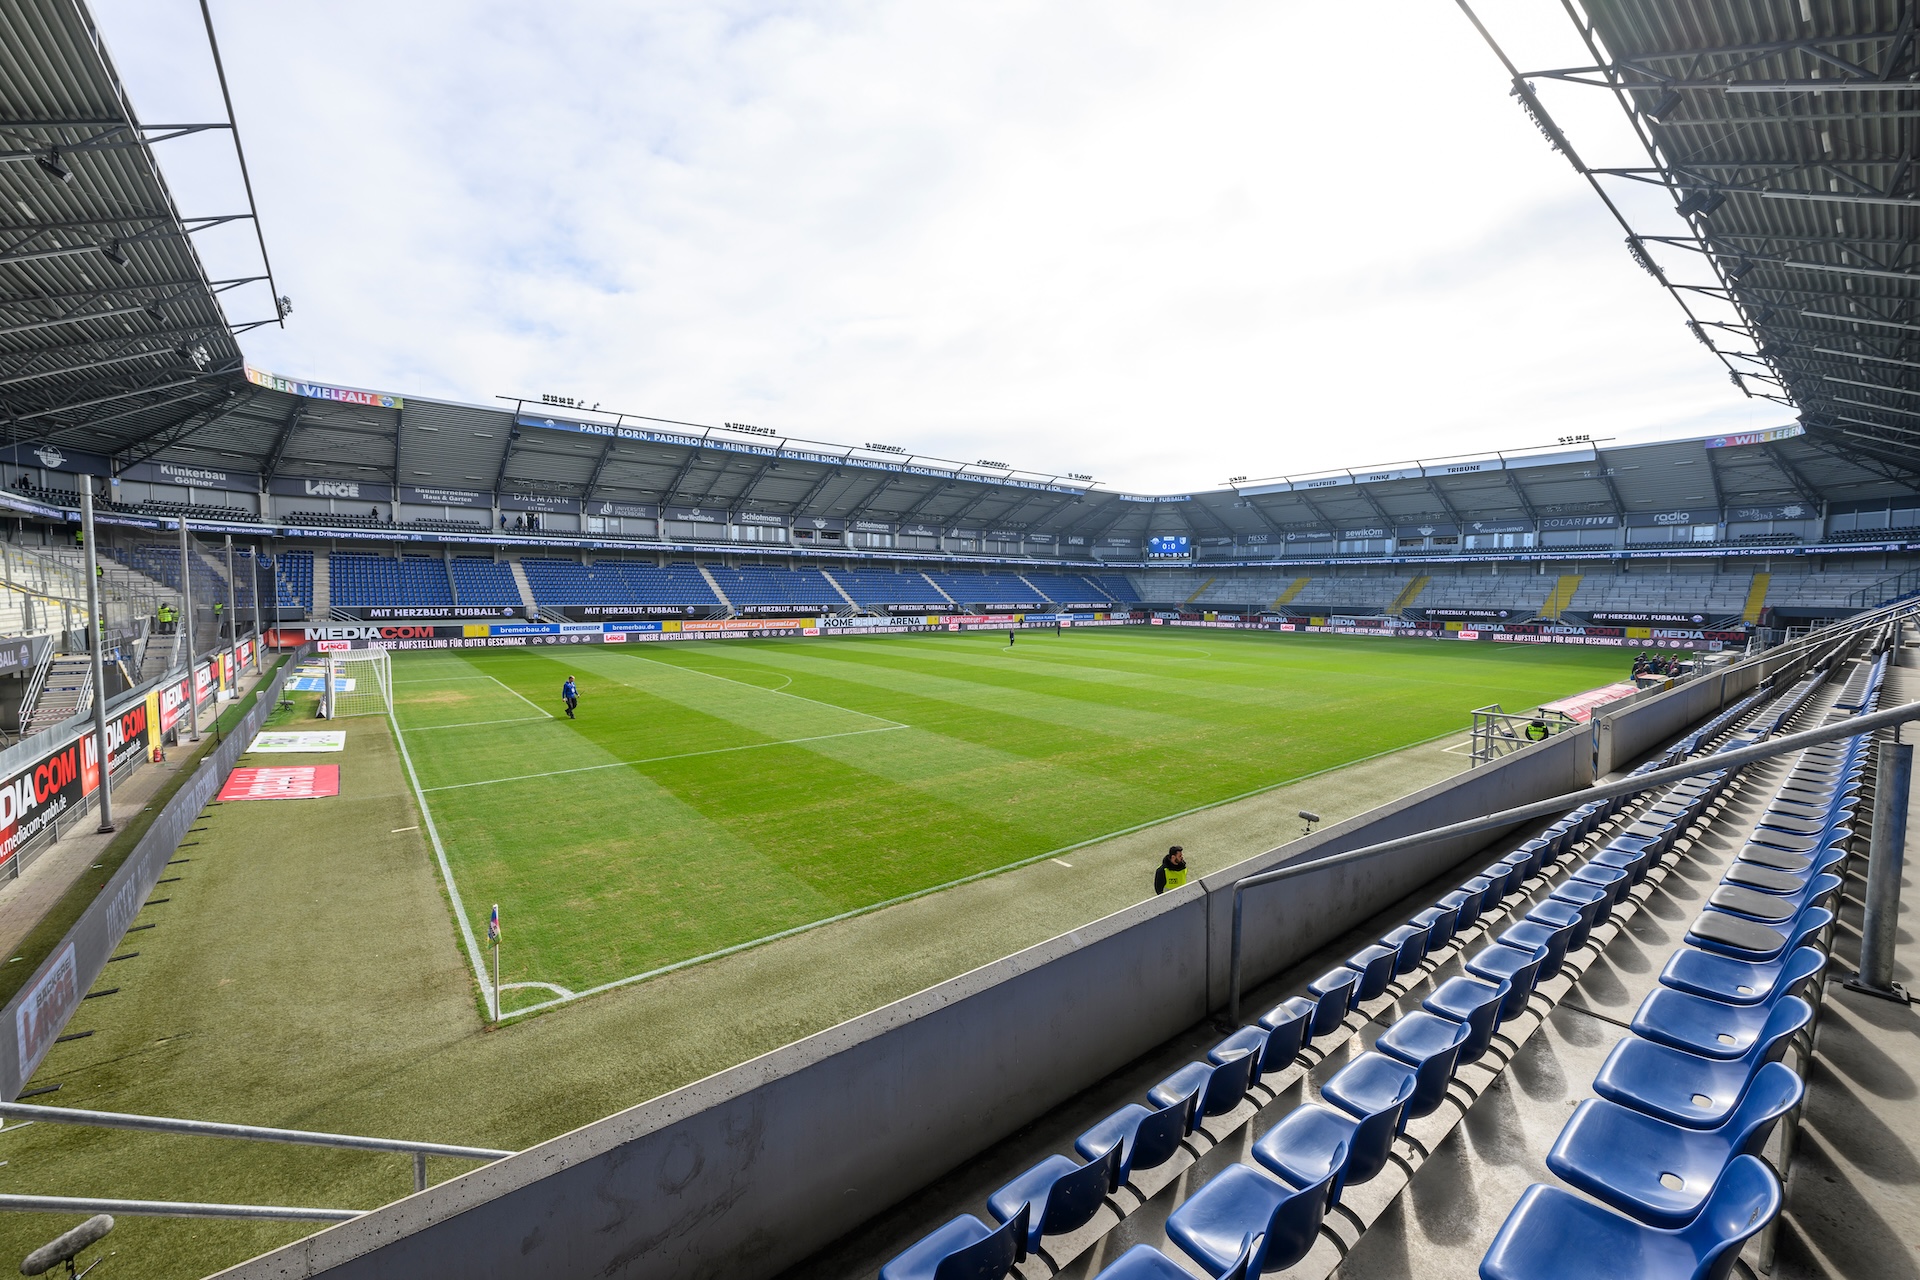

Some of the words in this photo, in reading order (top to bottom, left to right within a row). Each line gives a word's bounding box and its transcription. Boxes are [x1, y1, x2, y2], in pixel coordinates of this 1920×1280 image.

[302, 384, 373, 405] VIELFALT
[1735, 433, 1764, 444] WIR
[580, 424, 614, 436] PADER
[618, 428, 651, 441] BORN,
[654, 434, 715, 449] PADERBORN
[722, 442, 750, 453] MEINE
[784, 450, 798, 459] ICH
[800, 452, 820, 462] LIEBE
[822, 454, 842, 464] DICH.
[846, 458, 888, 470] MANCHMAL
[910, 466, 929, 475] DOCH
[930, 470, 950, 478] IMMER
[160, 464, 226, 481] Klinkerbau
[1447, 464, 1480, 474] TRIBÜNE
[174, 476, 214, 487] Göllner
[1308, 480, 1337, 488] WILFRIED
[305, 480, 360, 498] LANGE
[415, 488, 478, 497] Bauunternehmen
[514, 492, 568, 505] DALMANN
[742, 512, 782, 522] Schlotmann
[1654, 510, 1690, 522] radio
[856, 521, 889, 529] Schlotmann
[318, 531, 352, 539] Driburger
[353, 533, 408, 542] Naturparkquellen
[370, 609, 391, 617] MIT
[398, 608, 452, 616] HERZBLUT.
[454, 607, 500, 616] FUßBALL.
[1110, 612, 1144, 620] MEDIACOM
[1154, 612, 1200, 620] MEDIACOM
[890, 618, 920, 626] ARENA
[1384, 620, 1440, 628] MEDIACOM
[500, 626, 550, 634] bremerbau.de
[1468, 623, 1534, 632] MEDIACOM
[1544, 626, 1620, 636] MEDIACOM
[304, 626, 434, 640] MEDIACOM
[638, 634, 659, 642] UNSERE
[660, 632, 694, 641] AUFSTELLUNG
[694, 630, 704, 640] FÜR
[1654, 630, 1745, 640] MEDIACOM
[368, 641, 398, 650] UNSERE
[398, 639, 448, 650] AUFSTELLUNG
[450, 638, 462, 648] FÜR
[464, 638, 486, 648] GUTEN
[488, 637, 526, 646] GESCHMACK
[1493, 634, 1513, 642] UNSERE
[1514, 634, 1552, 643] AUFSTELLUNG
[1552, 634, 1564, 643] FÜR
[1585, 638, 1622, 646] GESCHMACK
[84, 705, 147, 769] MDIACOM
